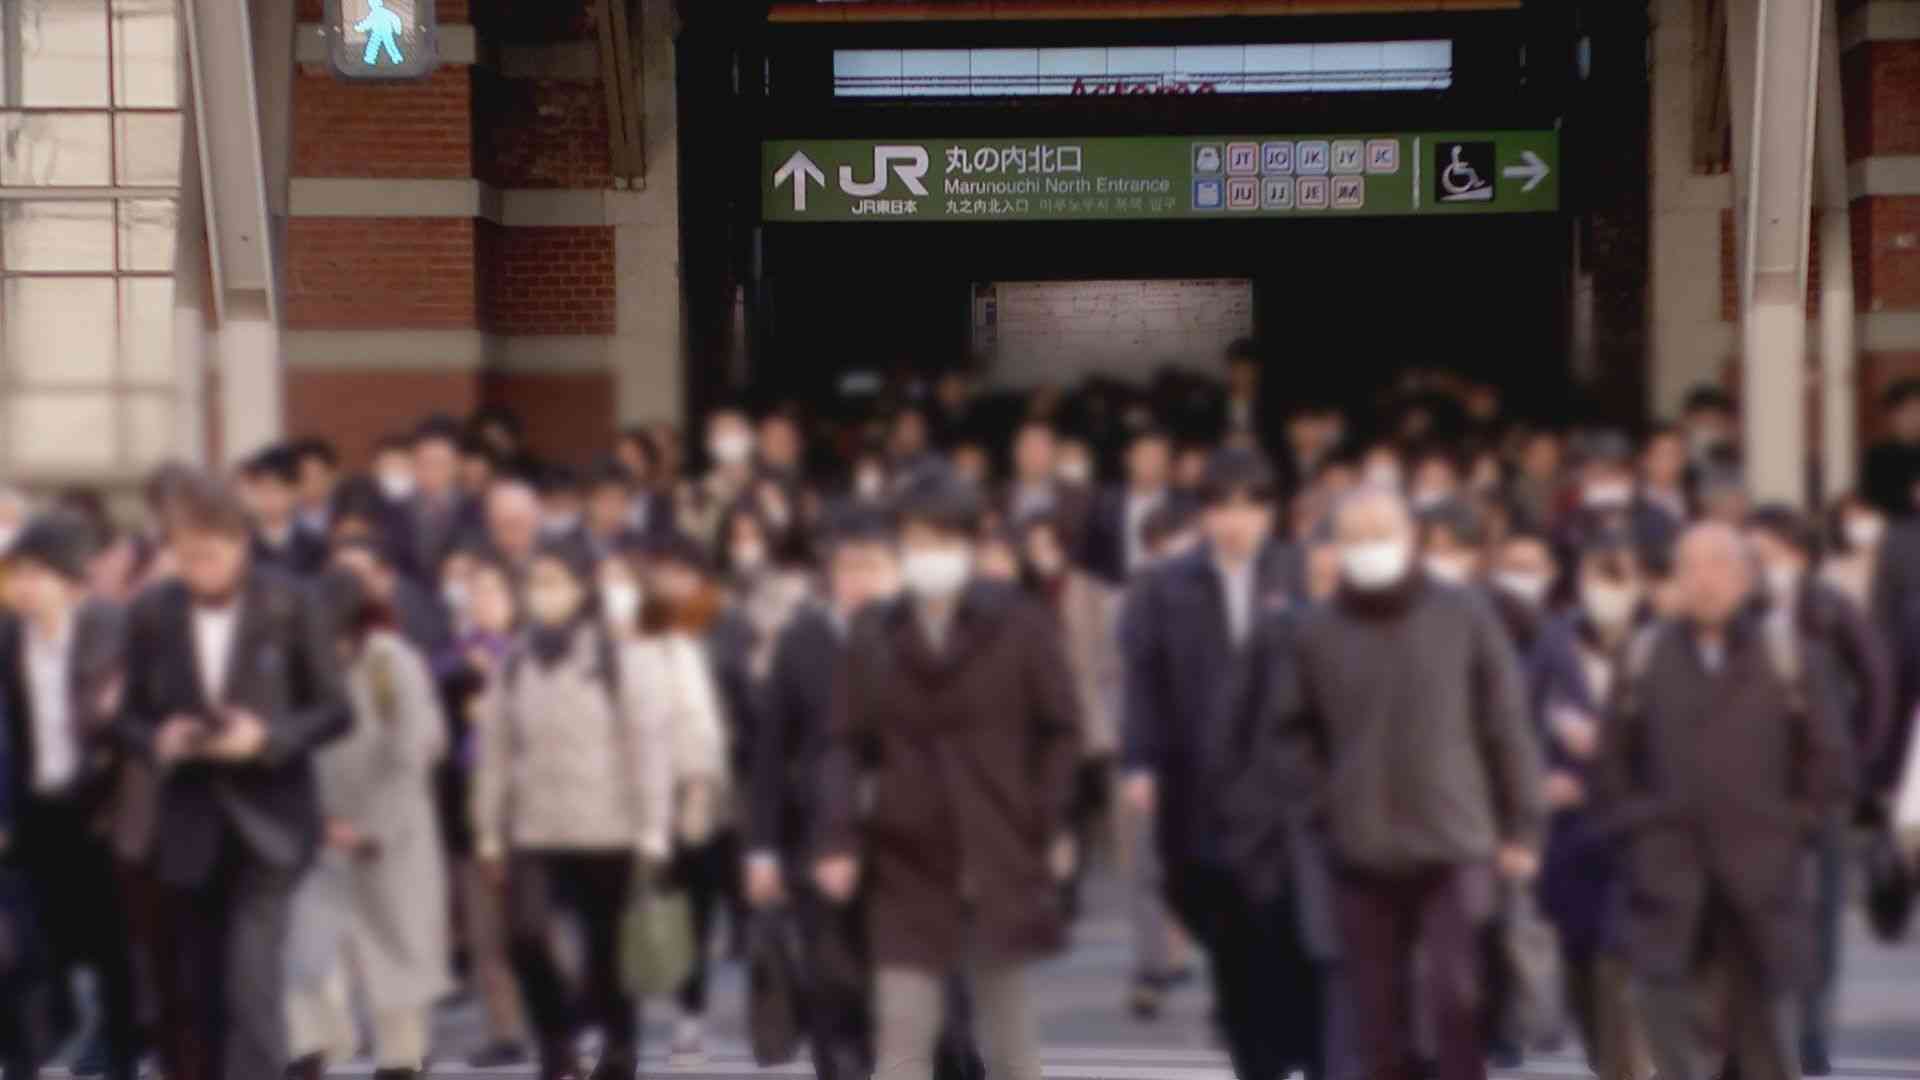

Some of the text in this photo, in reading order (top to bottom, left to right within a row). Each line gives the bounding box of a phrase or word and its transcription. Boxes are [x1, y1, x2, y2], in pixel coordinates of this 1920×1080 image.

[945, 145, 1082, 173] 丸の内北口
[1268, 151, 1288, 165] JO
[1304, 150, 1321, 164] JK
[1340, 149, 1357, 163] JY
[839, 146, 929, 196] JR
[944, 177, 1170, 194] Marunouchi North Entrance
[1234, 187, 1252, 200] JU
[1271, 186, 1286, 200] JJ
[852, 200, 917, 215] JR東日本
[945, 198, 1029, 214] 丸之内北入口
